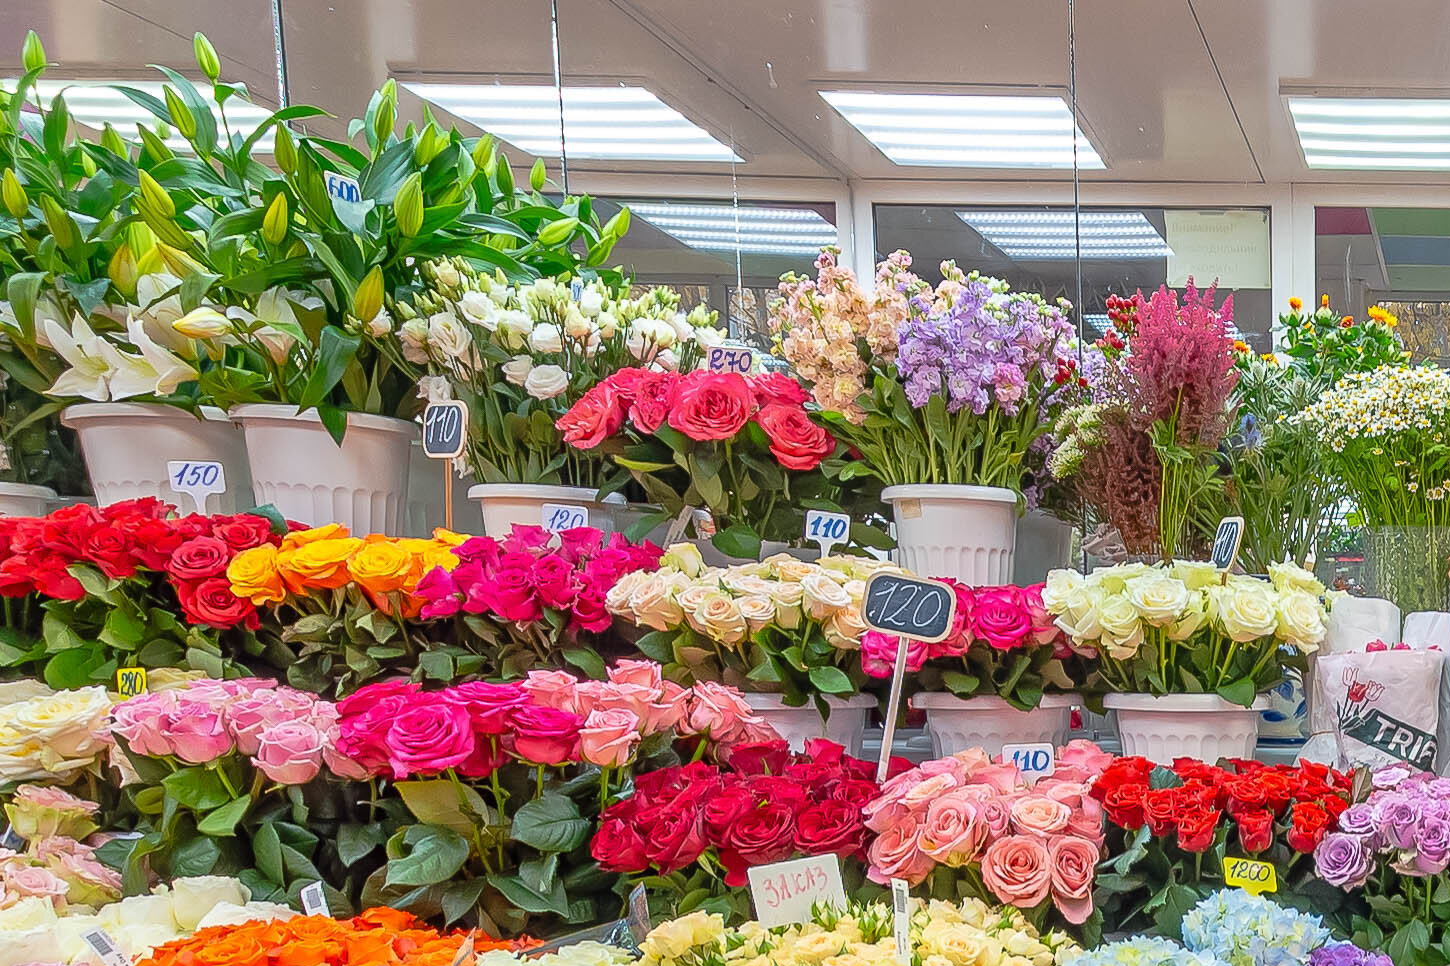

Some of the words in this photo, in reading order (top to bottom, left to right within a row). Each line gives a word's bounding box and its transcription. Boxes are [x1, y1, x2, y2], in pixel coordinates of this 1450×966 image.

[710, 348, 752, 373] 270
[426, 406, 458, 444] 110
[173, 463, 219, 486] 150
[548, 508, 585, 530] 120
[810, 515, 847, 539] 110
[1215, 523, 1237, 562] 110
[875, 582, 942, 627] 120
[121, 671, 144, 697] 280
[1012, 750, 1050, 771] 110
[1230, 860, 1271, 882] 1200
[763, 864, 828, 908] ЗАКАЗ
